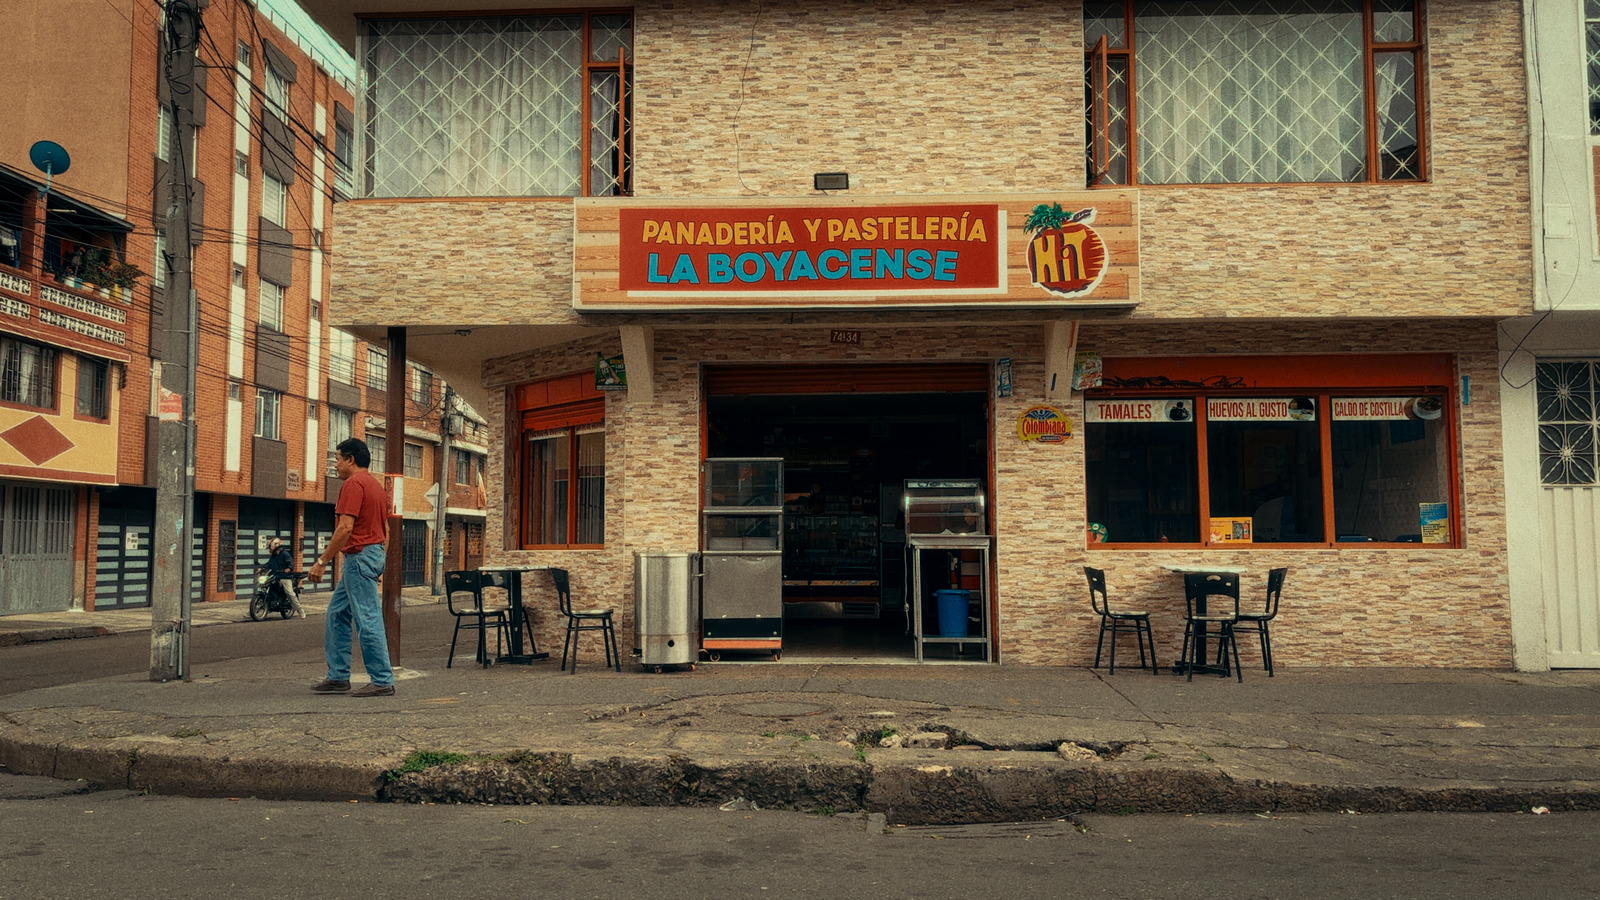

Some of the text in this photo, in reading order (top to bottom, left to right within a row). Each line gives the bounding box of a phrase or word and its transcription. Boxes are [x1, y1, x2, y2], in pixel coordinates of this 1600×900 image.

[642, 211, 988, 246] PANADERÍA Y PASTELERÍA
[647, 248, 959, 284] LA BOYACENSE
[1098, 404, 1152, 420] TAMALES
[1209, 402, 1288, 417] HUEVOS AL GUSTO
[1334, 402, 1404, 416] CALDO DE COSTILLA
[1022, 419, 1067, 437] Colombiana
